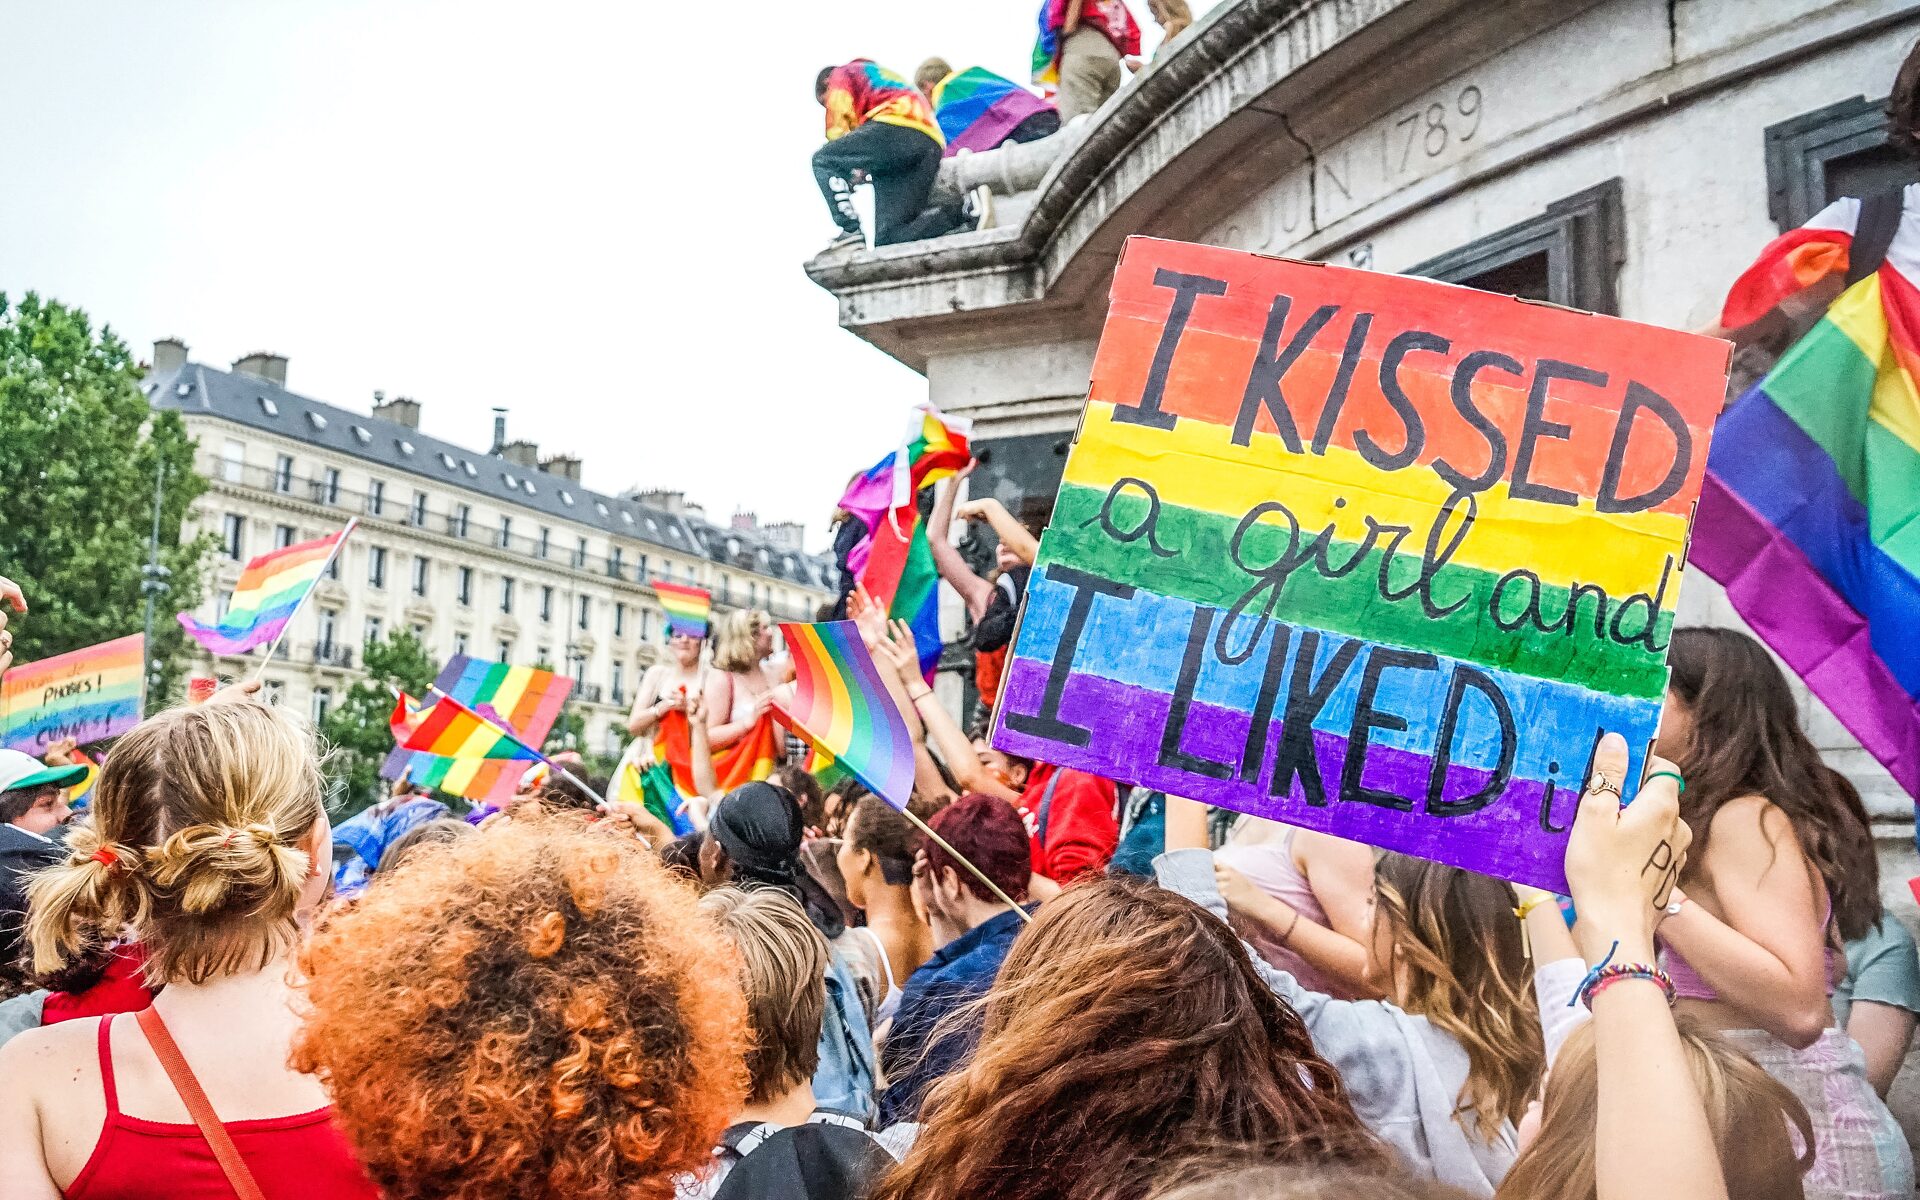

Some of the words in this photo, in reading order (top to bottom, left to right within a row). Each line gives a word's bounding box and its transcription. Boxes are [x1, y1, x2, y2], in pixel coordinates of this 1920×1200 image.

[1380, 83, 1484, 183] 1789
[1112, 267, 1227, 431] I
[1231, 294, 1694, 515] KISSED
[1078, 477, 1180, 557] a
[1214, 489, 1477, 667] girl
[1489, 554, 1672, 653] and
[1005, 563, 1136, 749] I
[1156, 606, 1519, 818] LIKED
